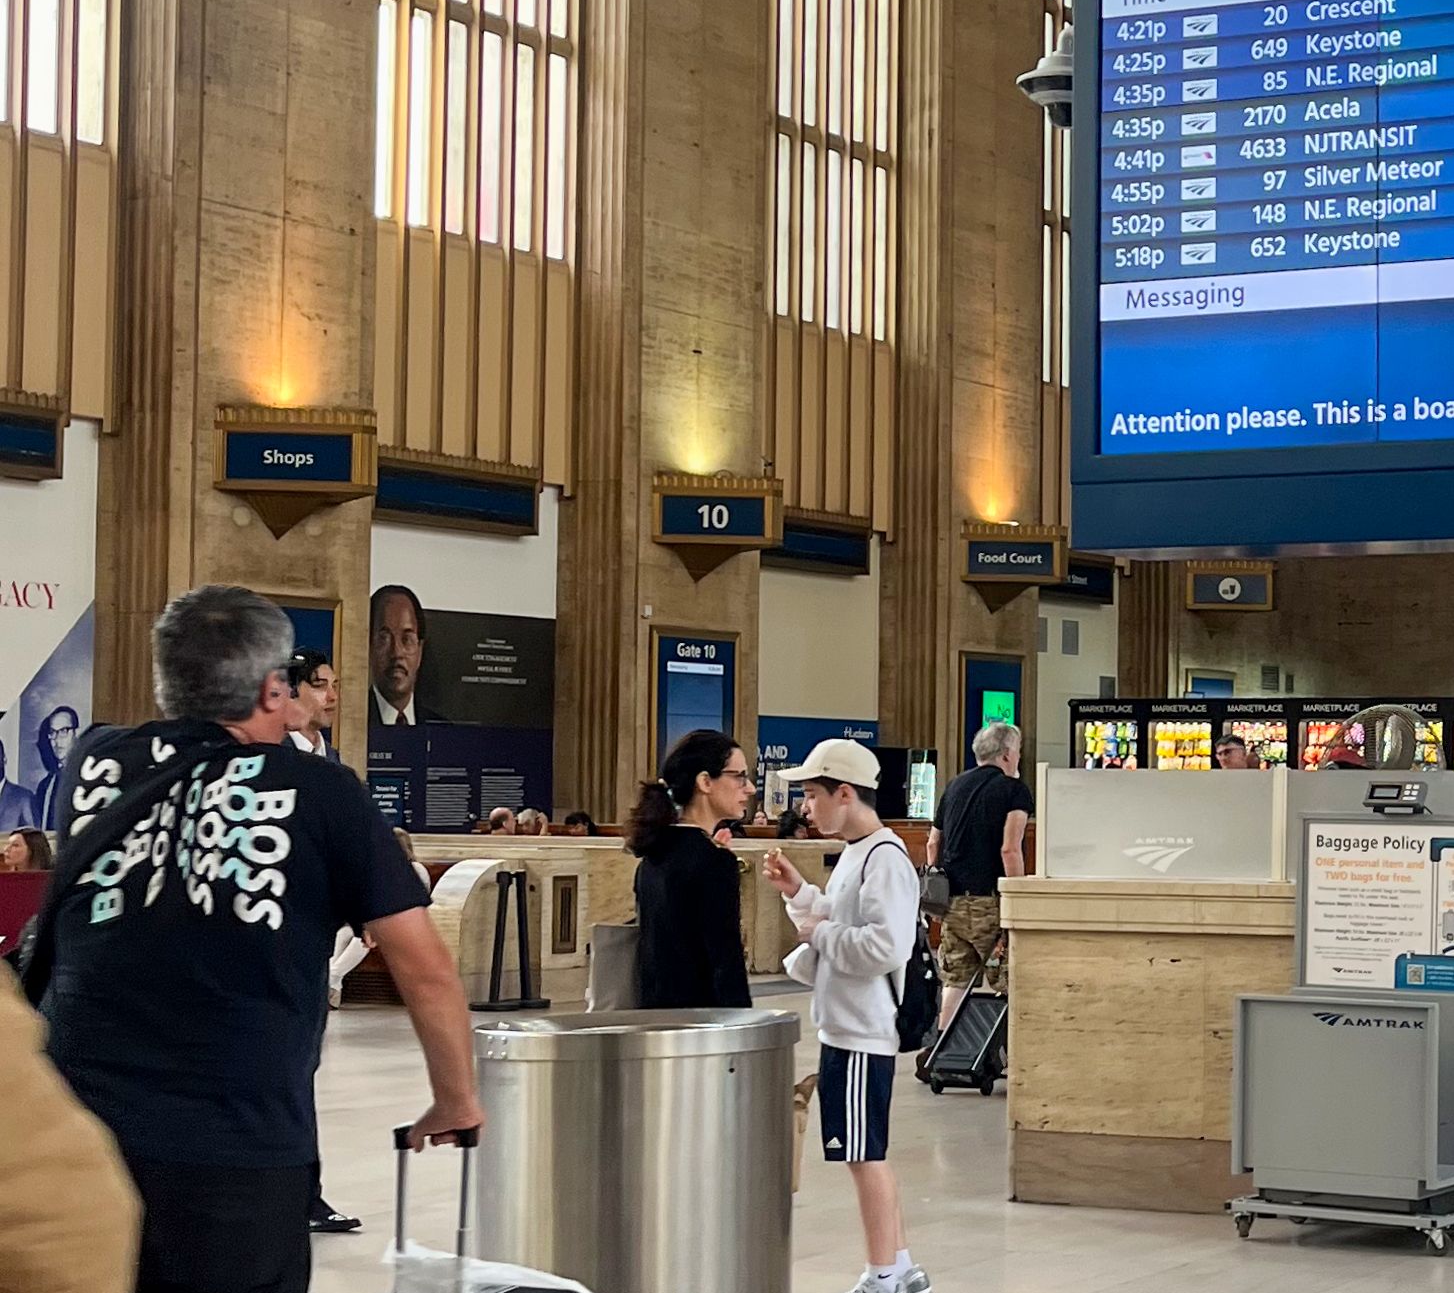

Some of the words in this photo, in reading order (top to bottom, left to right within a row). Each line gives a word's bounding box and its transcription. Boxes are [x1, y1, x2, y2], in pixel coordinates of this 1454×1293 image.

[1116, 19, 1167, 43] 4:21p
[1263, 5, 1288, 26] 20
[1113, 52, 1167, 74] 4:25p
[1250, 37, 1288, 59] 649
[1305, 28, 1402, 57] Keystone
[1113, 84, 1166, 106] 4:35p
[1263, 70, 1288, 92] 85
[1305, 64, 1343, 87] N.E.
[1348, 53, 1437, 86] Regional
[1112, 117, 1165, 140] 4:35p
[1243, 104, 1287, 127] 2170
[1304, 96, 1361, 122] Acela
[1114, 149, 1165, 172] 4:41p
[1239, 137, 1287, 160] 4633
[1304, 124, 1418, 154] NJTRANSIT
[1111, 182, 1165, 204] 4:55p
[1263, 169, 1287, 192] 97
[1304, 165, 1361, 188] Silver
[1365, 159, 1445, 182] Meteor
[1111, 214, 1165, 237] 5:02p
[1252, 202, 1287, 225] 148
[1304, 198, 1342, 221] N.E.
[1346, 189, 1437, 220] Regional
[1115, 246, 1165, 269] 5:18p
[1250, 235, 1287, 258] 652
[1304, 230, 1400, 257] Keystone
[1125, 282, 1245, 309] Messaging
[1111, 408, 1220, 437] Attention
[1226, 405, 1308, 435] please.
[1313, 398, 1360, 426] This
[1367, 397, 1387, 423] is
[1392, 401, 1407, 422] a
[262, 449, 314, 468] Shops
[697, 504, 729, 529] 10
[977, 552, 1006, 563] Food
[1009, 552, 1043, 564] Court
[677, 642, 702, 658] Gate
[703, 644, 716, 659] 10
[1078, 704, 1133, 714] MARKETPLACE
[1151, 704, 1207, 713] MARKETPLACE
[1227, 704, 1283, 713] MARKETPLACE
[1303, 703, 1360, 712] MARKETPLACE
[764, 745, 788, 759] AND
[1135, 836, 1194, 844] AMTRAK
[1316, 834, 1379, 852] Baggage
[1383, 835, 1426, 854] Policy
[233, 788, 298, 931] BOSS
[1315, 856, 1336, 867] ONE
[1338, 858, 1380, 869] personal
[1406, 860, 1425, 870] and
[1325, 870, 1348, 880] TWO
[1350, 871, 1374, 883] bags
[1375, 872, 1390, 882] for
[1342, 1018, 1425, 1030] AMTRAK
